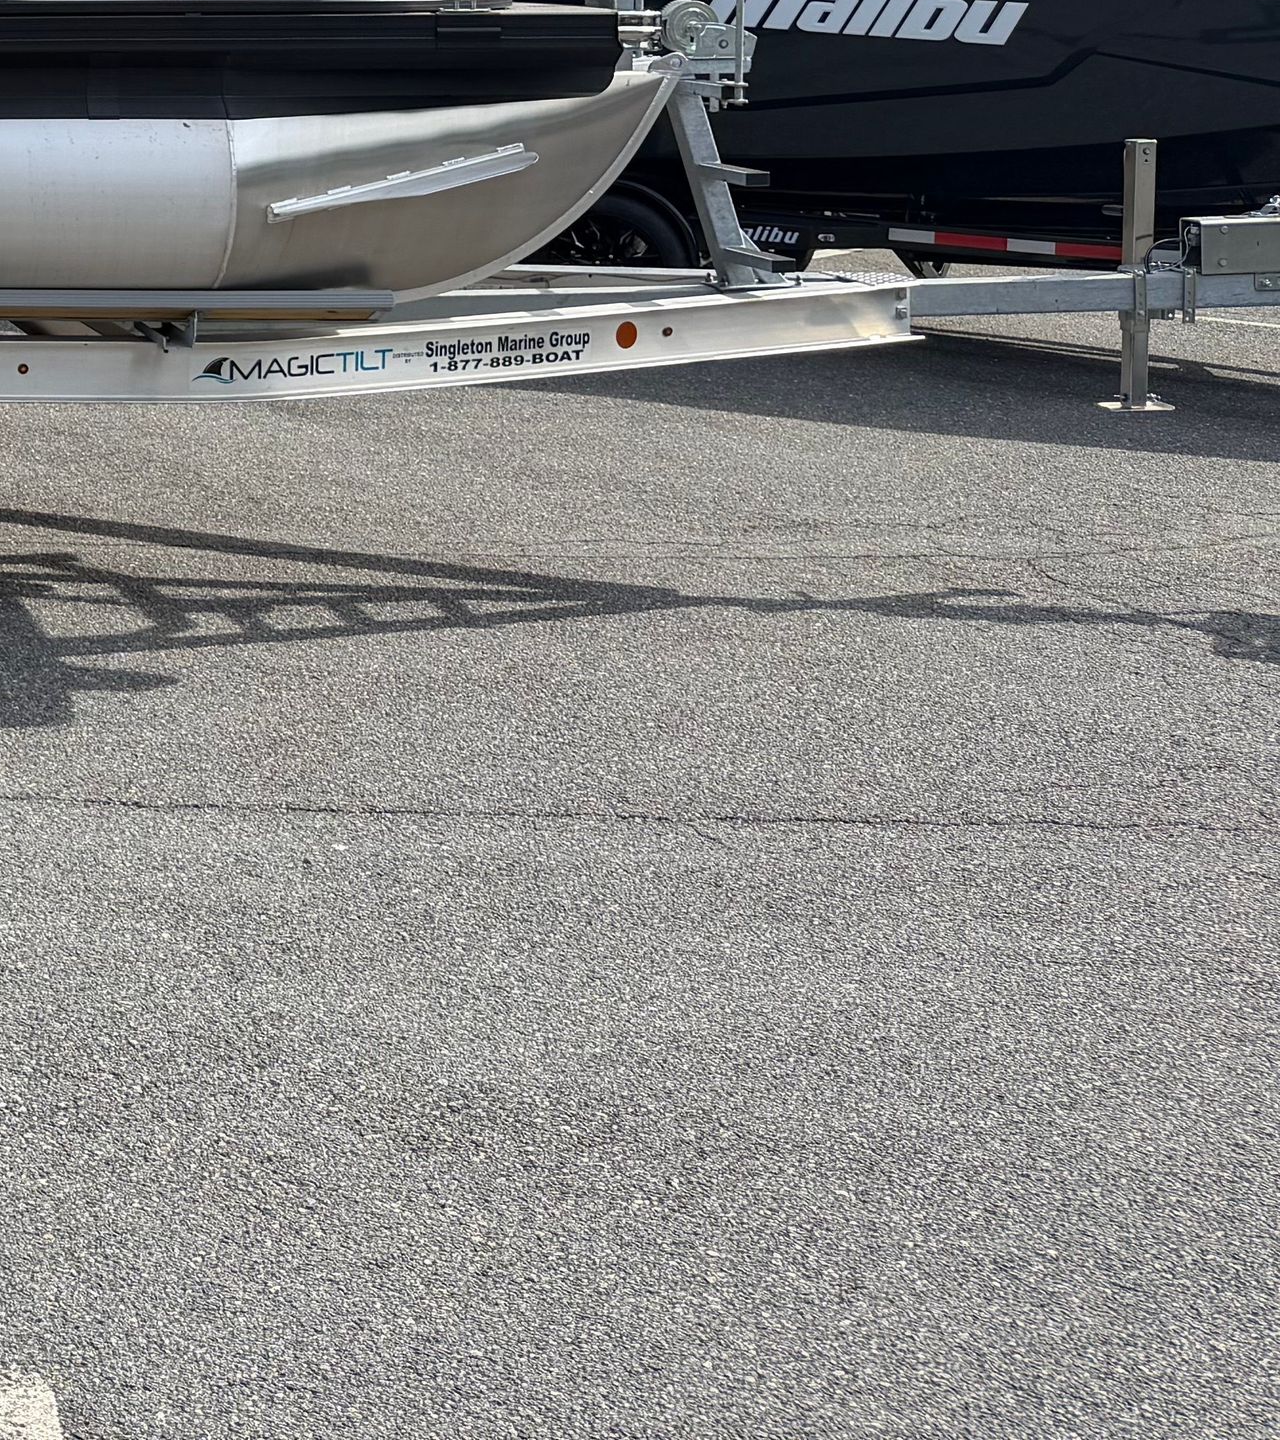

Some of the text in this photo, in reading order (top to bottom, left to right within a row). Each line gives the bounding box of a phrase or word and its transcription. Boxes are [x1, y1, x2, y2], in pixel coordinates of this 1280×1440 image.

[425, 331, 591, 361] Singleton Marine Group
[429, 349, 584, 373] 1-877-889-BOAT
[229, 348, 393, 381] MAGICTILT
